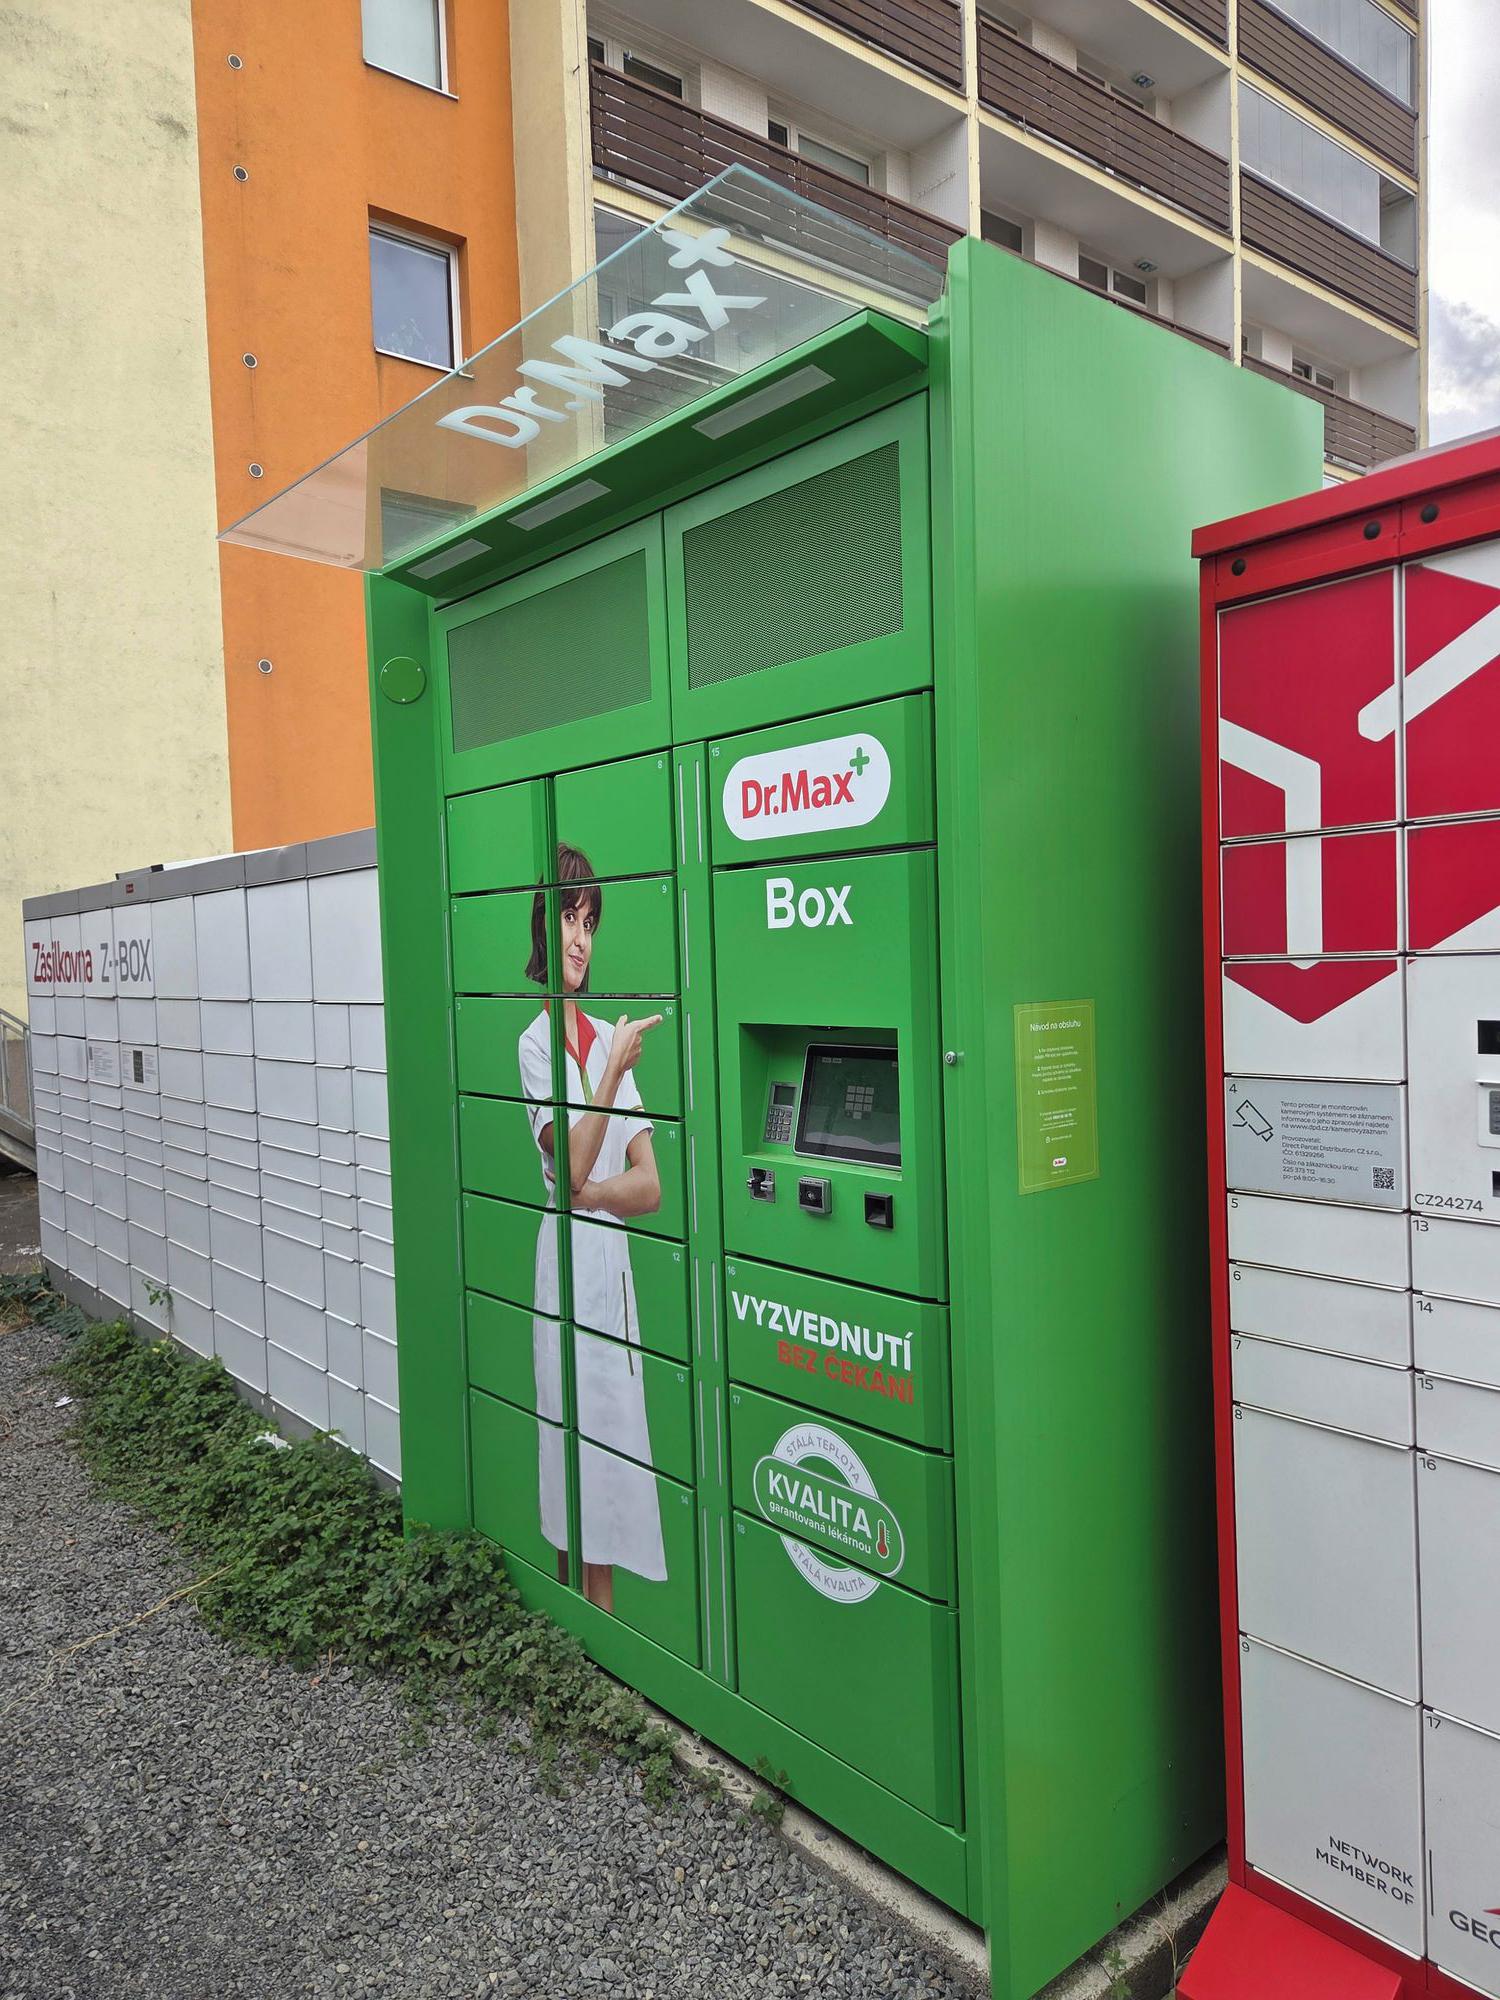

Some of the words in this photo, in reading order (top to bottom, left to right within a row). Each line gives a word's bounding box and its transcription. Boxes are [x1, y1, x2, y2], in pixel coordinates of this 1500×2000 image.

[766, 877, 854, 929] Box
[32, 941, 93, 983] Zásilkovna
[1228, 1084, 1238, 1094] 4
[1298, 1102, 1320, 1110] prostor
[1320, 1145, 1356, 1154] Distribution
[1231, 1198, 1239, 1209] 5
[1414, 1193, 1484, 1213] CZ24274
[1412, 1219, 1429, 1232] 13
[1233, 1270, 1241, 1281] 6
[1417, 1300, 1434, 1314] 14
[732, 1291, 914, 1371] VYZVEDNUTÍ
[1234, 1339, 1242, 1350] 7
[777, 1340, 818, 1374] BEZ
[824, 1349, 914, 1406] ČEKÁNÍ
[1417, 1377, 1434, 1390] 15
[1234, 1409, 1243, 1420] 8
[786, 1432, 815, 1457] STÁLÁ
[816, 1436, 860, 1483] TEPLOTA
[1419, 1457, 1437, 1471] 16
[768, 1469, 872, 1539] KVALITA
[769, 1501, 826, 1533] garantovaná
[827, 1525, 871, 1555] lékárnou
[792, 1542, 821, 1579] STÁLÁ
[823, 1575, 867, 1592] KVALITA
[1241, 1641, 1250, 1653] 9
[1426, 1716, 1442, 1730] 17
[1329, 1835, 1414, 1888] NETWORK
[1316, 1847, 1388, 1895] MEMBER
[1391, 1887, 1415, 1905] OF
